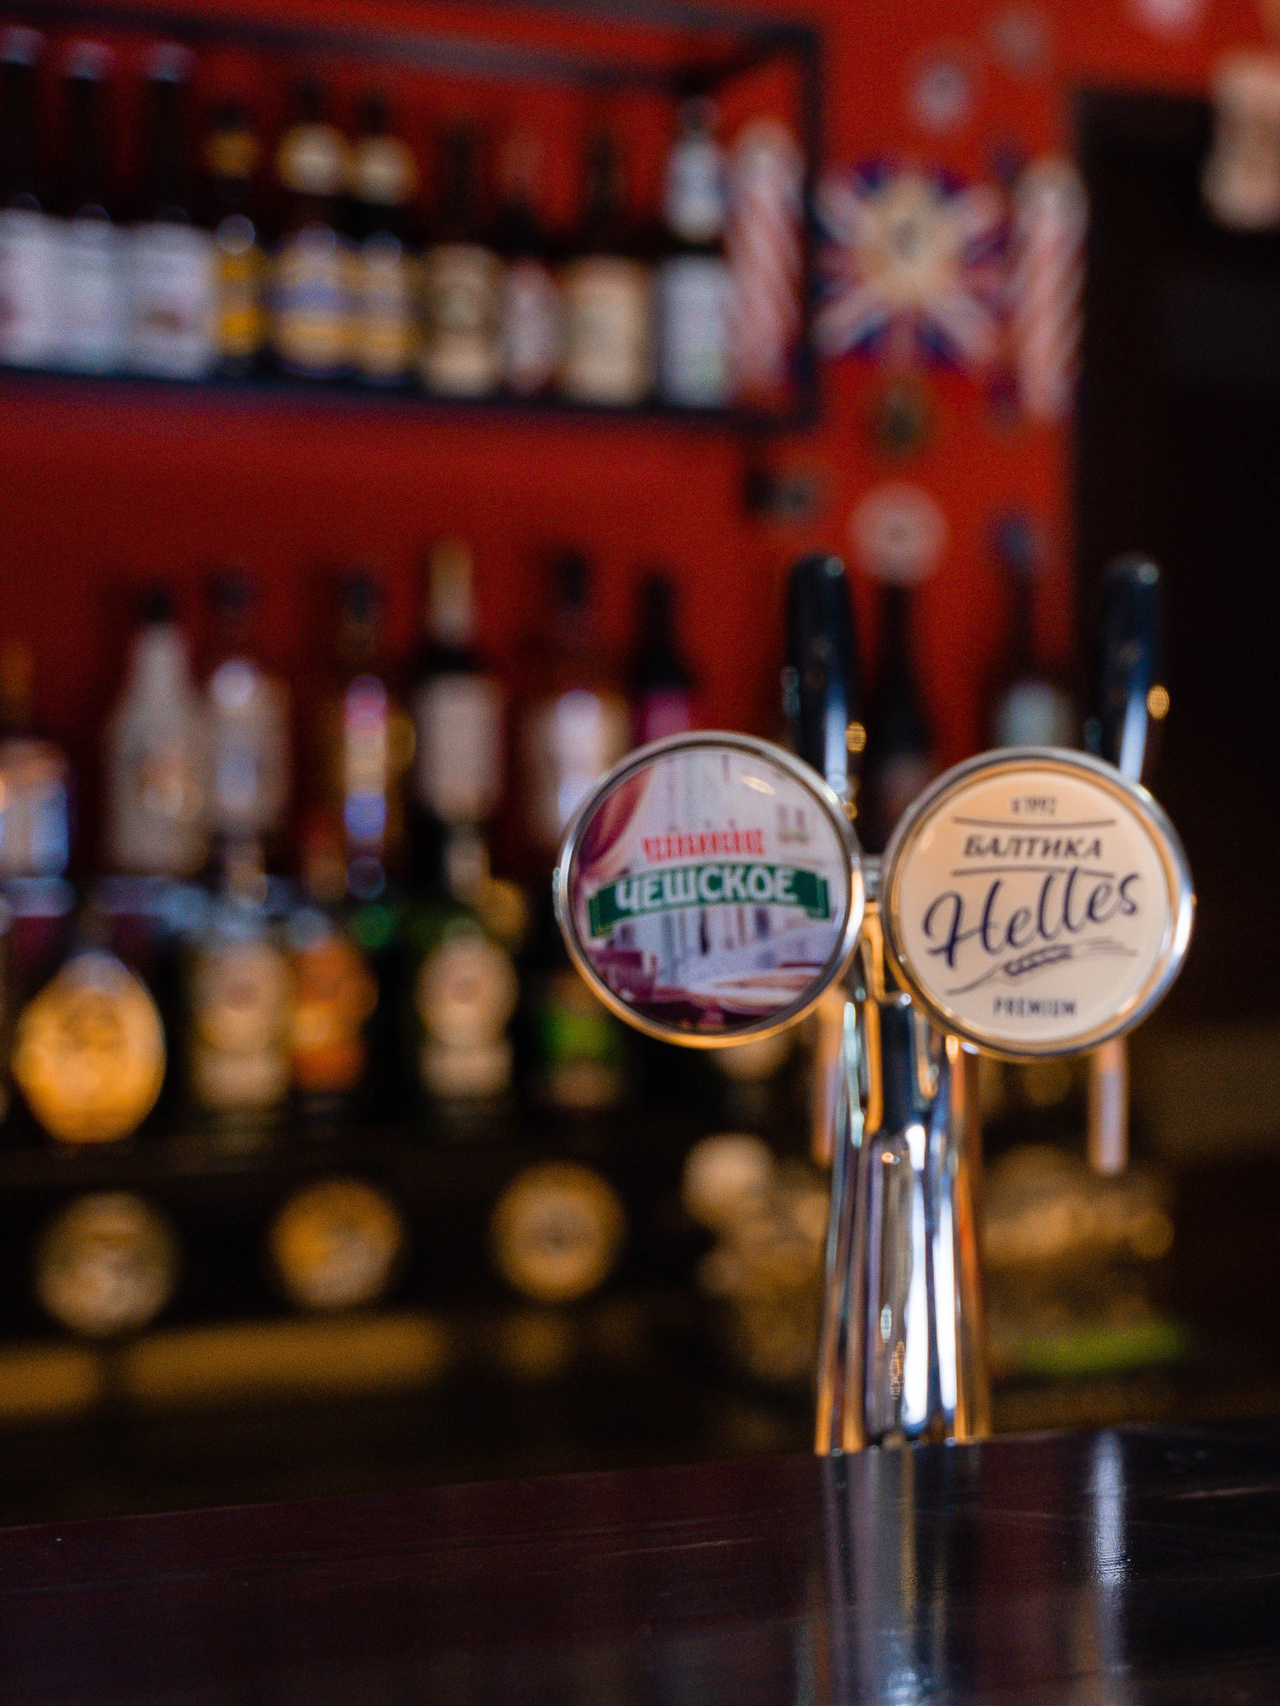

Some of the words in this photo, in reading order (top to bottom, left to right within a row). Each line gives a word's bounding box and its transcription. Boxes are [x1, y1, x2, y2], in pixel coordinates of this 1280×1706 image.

[964, 836, 1102, 858] БАЛТИКА
[614, 865, 798, 911] ЧЕШСКОЕ
[922, 866, 1140, 970] Helles
[993, 996, 1078, 1019] PREMIUM
